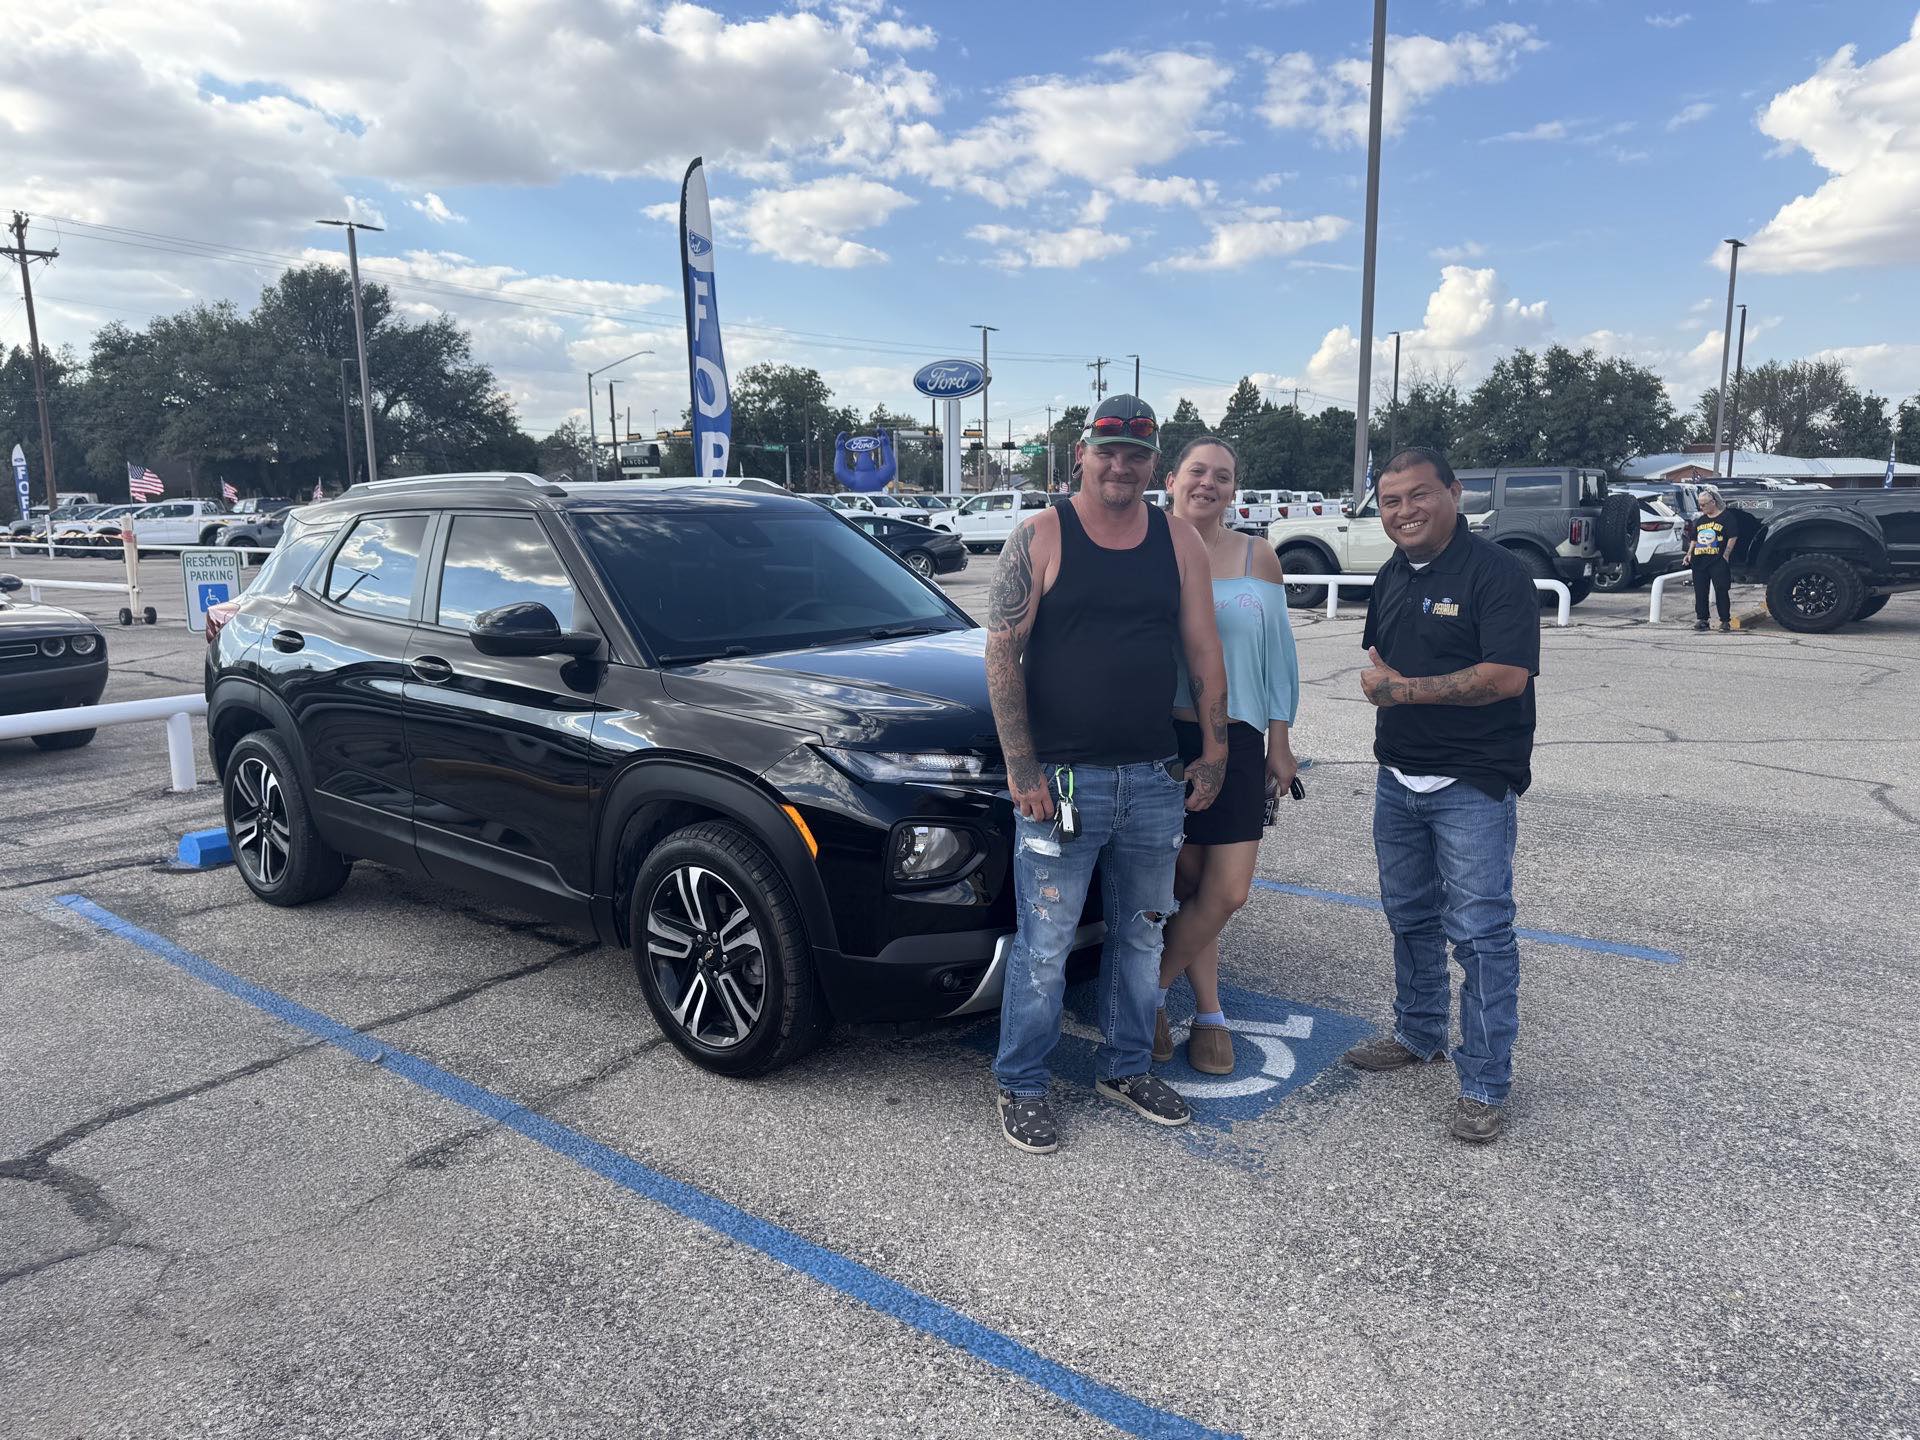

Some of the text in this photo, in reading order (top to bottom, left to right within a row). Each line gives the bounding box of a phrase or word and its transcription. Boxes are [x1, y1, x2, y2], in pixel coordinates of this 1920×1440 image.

[693, 277, 730, 478] FOR
[927, 366, 970, 391] Ford
[850, 438, 875, 450] Ford
[185, 556, 235, 568] RESERVED
[190, 570, 234, 581] PARKING
